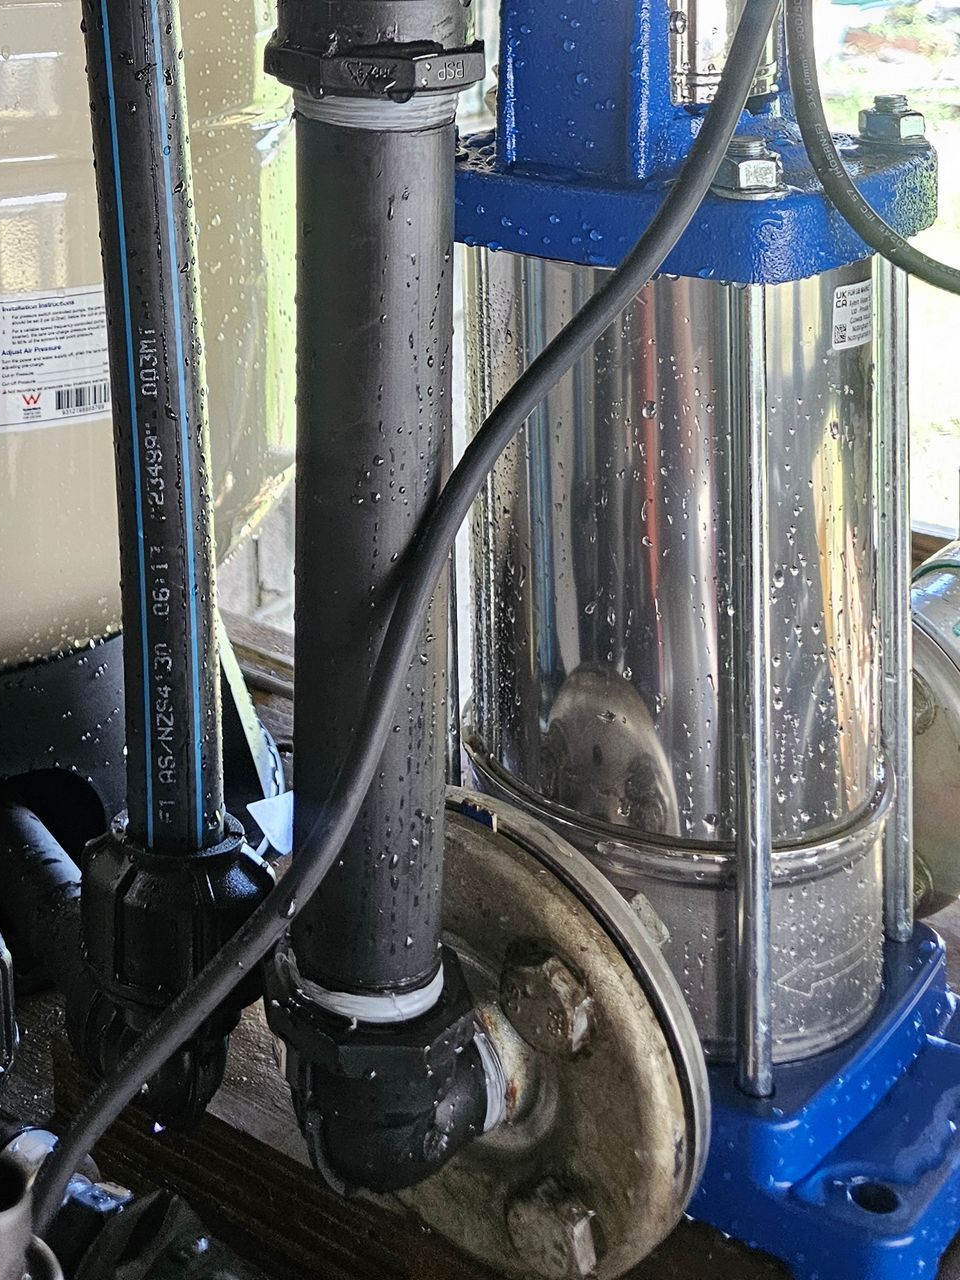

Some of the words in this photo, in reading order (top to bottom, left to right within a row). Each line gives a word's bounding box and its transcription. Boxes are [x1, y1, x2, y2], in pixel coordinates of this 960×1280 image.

[437, 58, 466, 81] BSP
[845, 189, 860, 203] 57
[860, 207, 876, 222] IEC
[835, 290, 848, 300] UK
[2, 304, 38, 312] Installation
[38, 300, 75, 308] Instructions
[835, 299, 848, 308] CA
